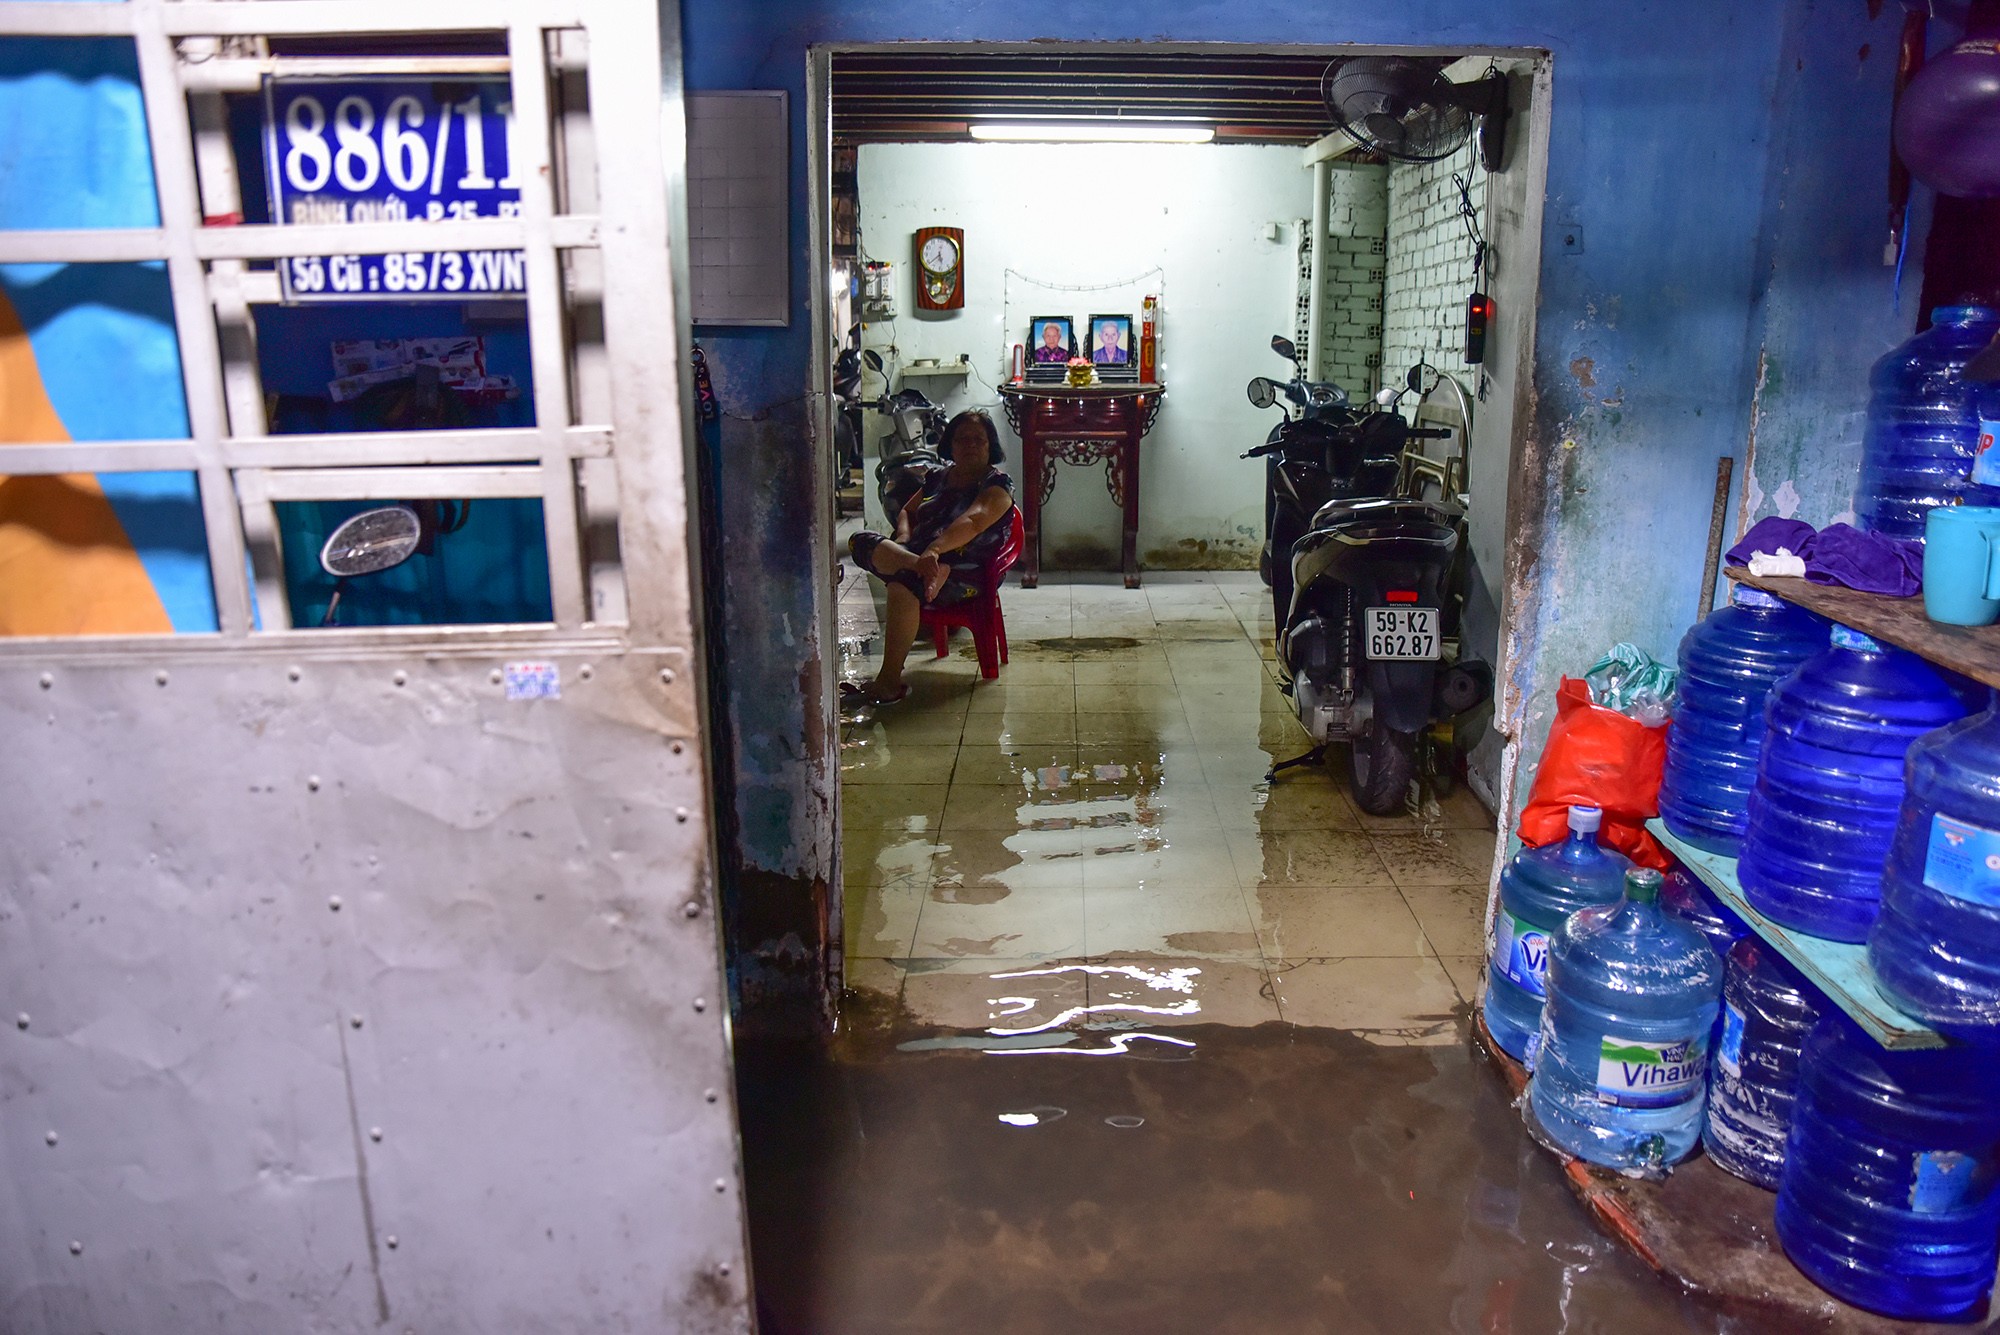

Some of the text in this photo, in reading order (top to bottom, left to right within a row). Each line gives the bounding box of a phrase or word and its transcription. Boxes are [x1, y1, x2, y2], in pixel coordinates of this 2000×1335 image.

[383, 252, 465, 291] 85/3
[1376, 611, 1428, 633] 59-K2
[1372, 635, 1433, 657] 662.87
